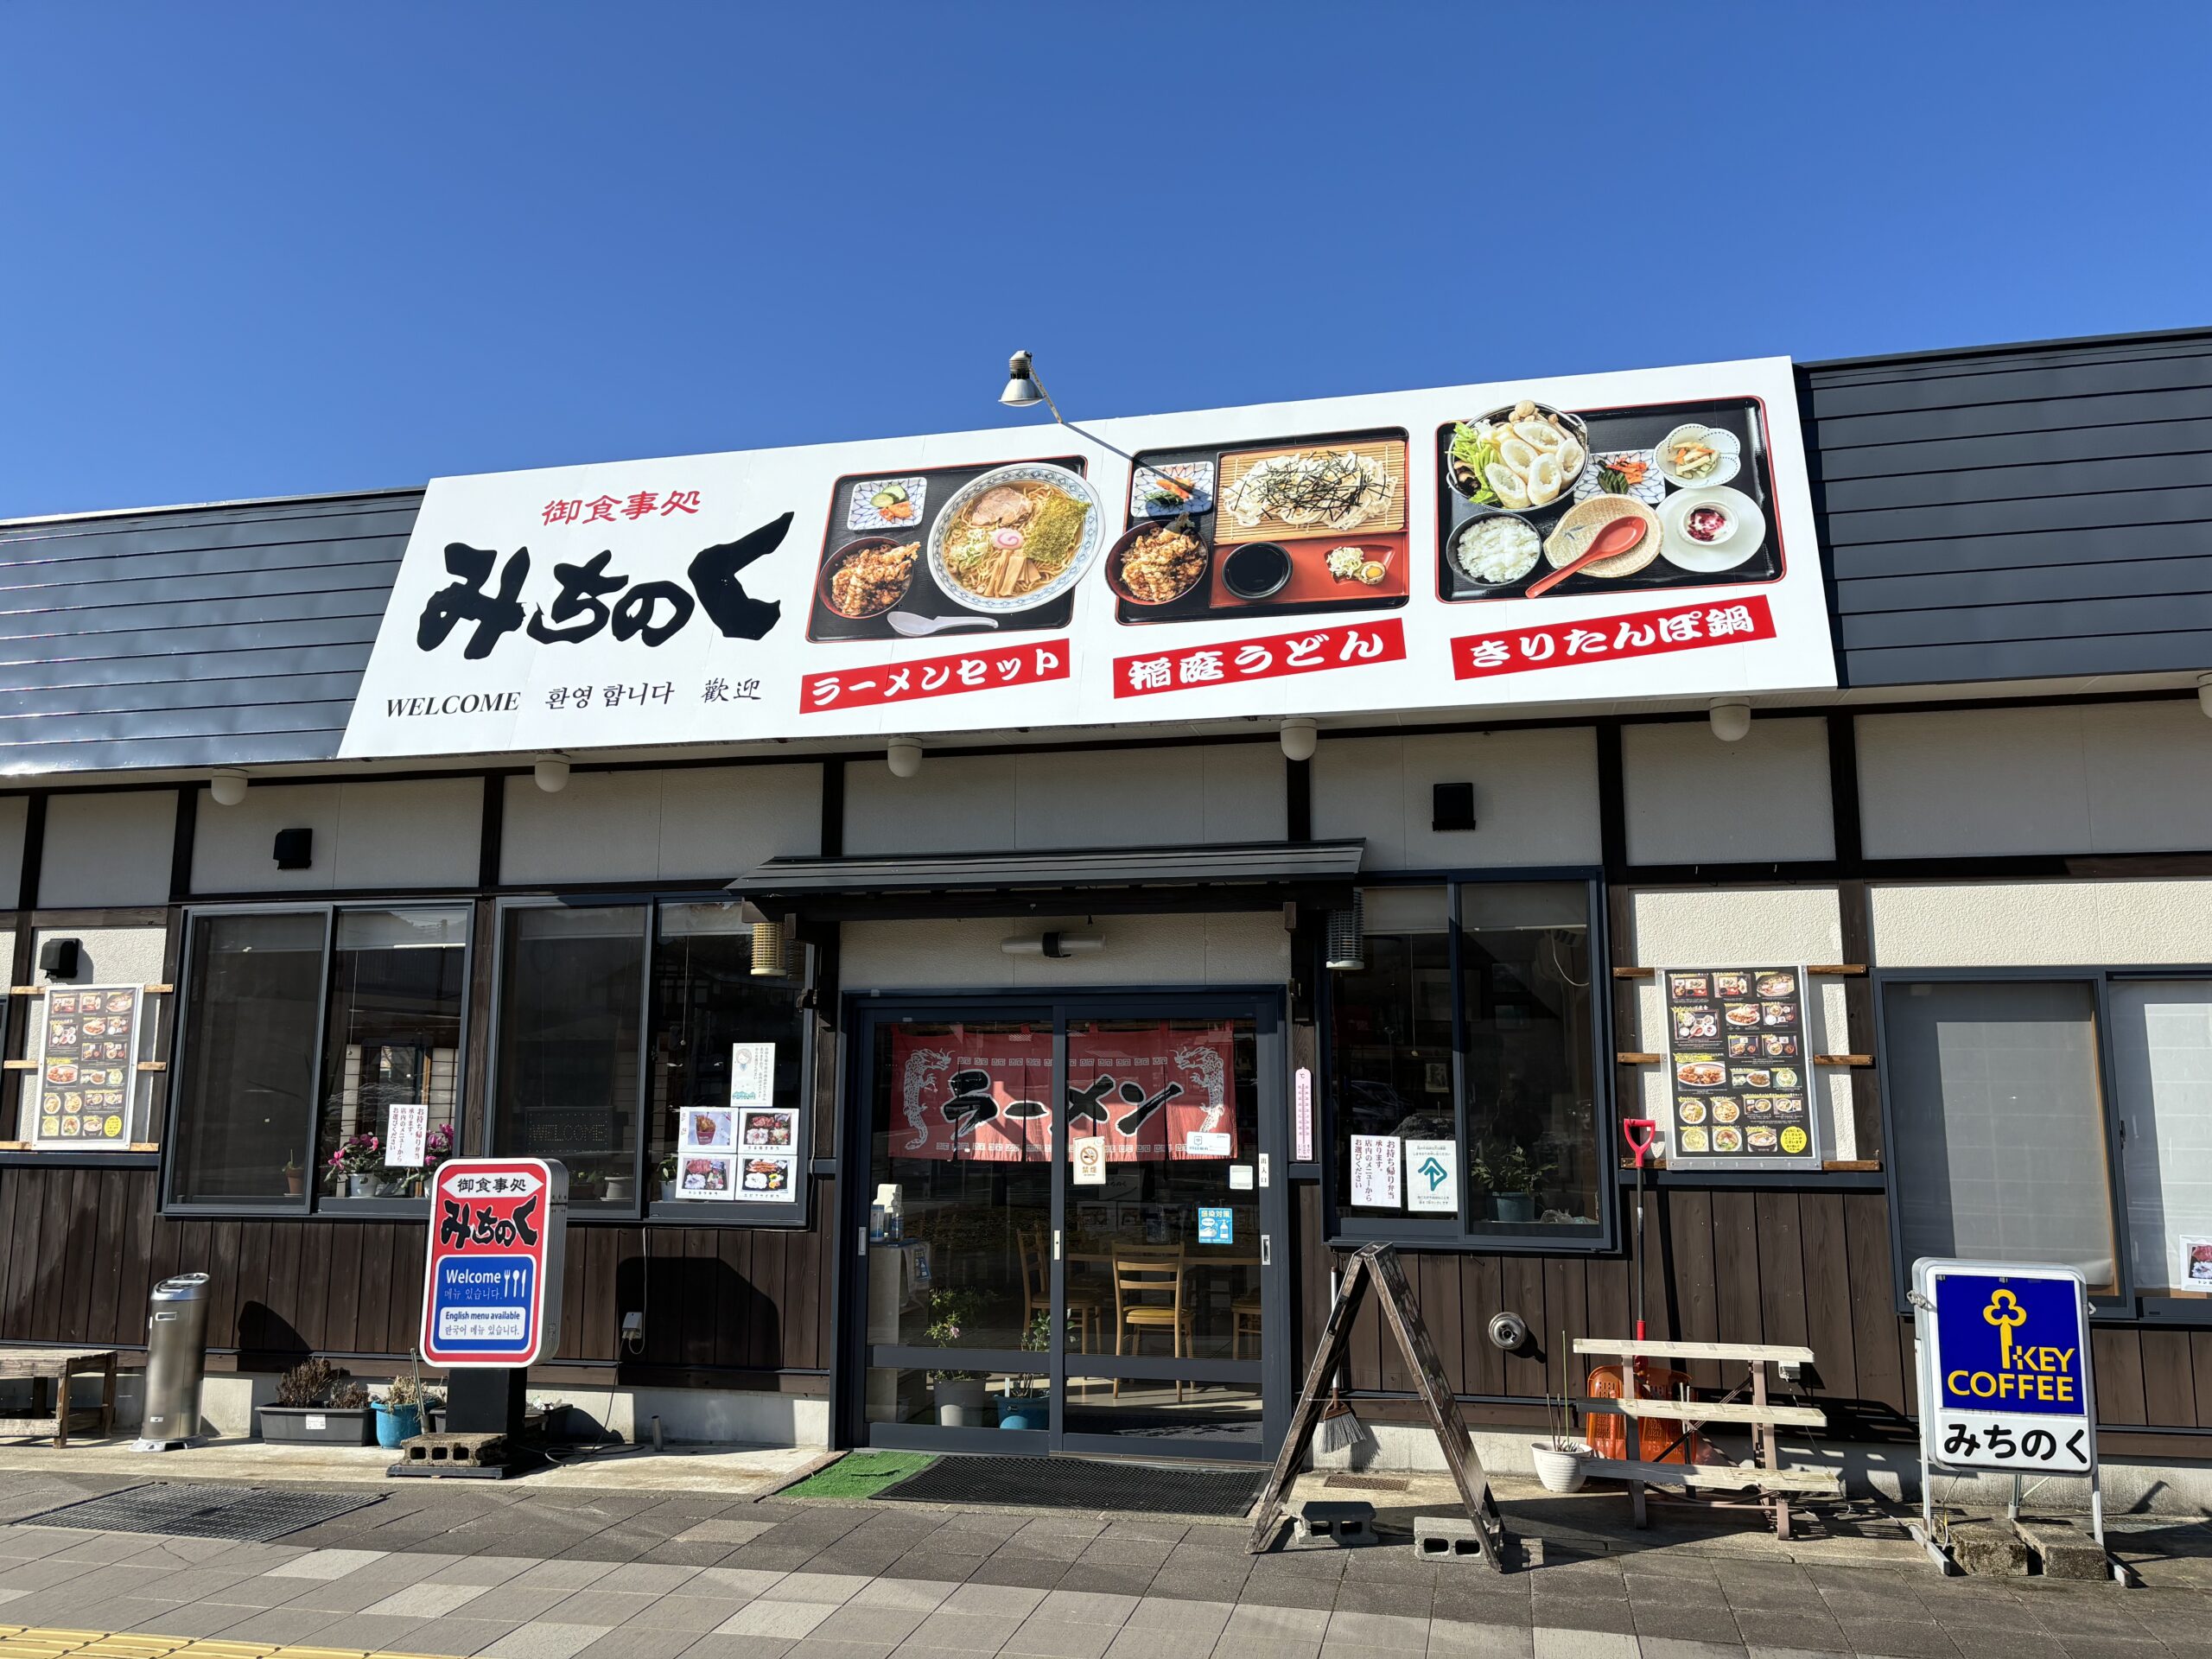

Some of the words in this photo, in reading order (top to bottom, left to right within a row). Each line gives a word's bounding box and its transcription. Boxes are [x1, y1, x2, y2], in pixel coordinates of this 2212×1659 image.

[542, 491, 701, 526] 御食事処
[416, 512, 794, 659] みちのく
[1470, 605, 1753, 668] きりたんぽ鍋
[810, 646, 1059, 706] ラーメンセット
[1128, 630, 1383, 690] 稲庭うどん
[386, 691, 521, 718] WELCOME
[545, 685, 593, 709] 환영
[602, 681, 675, 708] 합니다
[940, 1068, 1185, 1141] ラーメン
[532, 1124, 606, 1141] WELCOME
[457, 1177, 526, 1193] 御食事処
[1387, 1141, 1395, 1199] お持ち帰り弁当
[441, 1195, 537, 1249] みちのく
[446, 1268, 501, 1284] Welcome
[444, 1288, 461, 1300] 메뉴
[445, 1311, 469, 1321] English
[490, 1311, 520, 1319] available
[2012, 1345, 2075, 1372] KEY
[1947, 1370, 2074, 1402] COFFEE
[1944, 1423, 2088, 1464] みちのく
